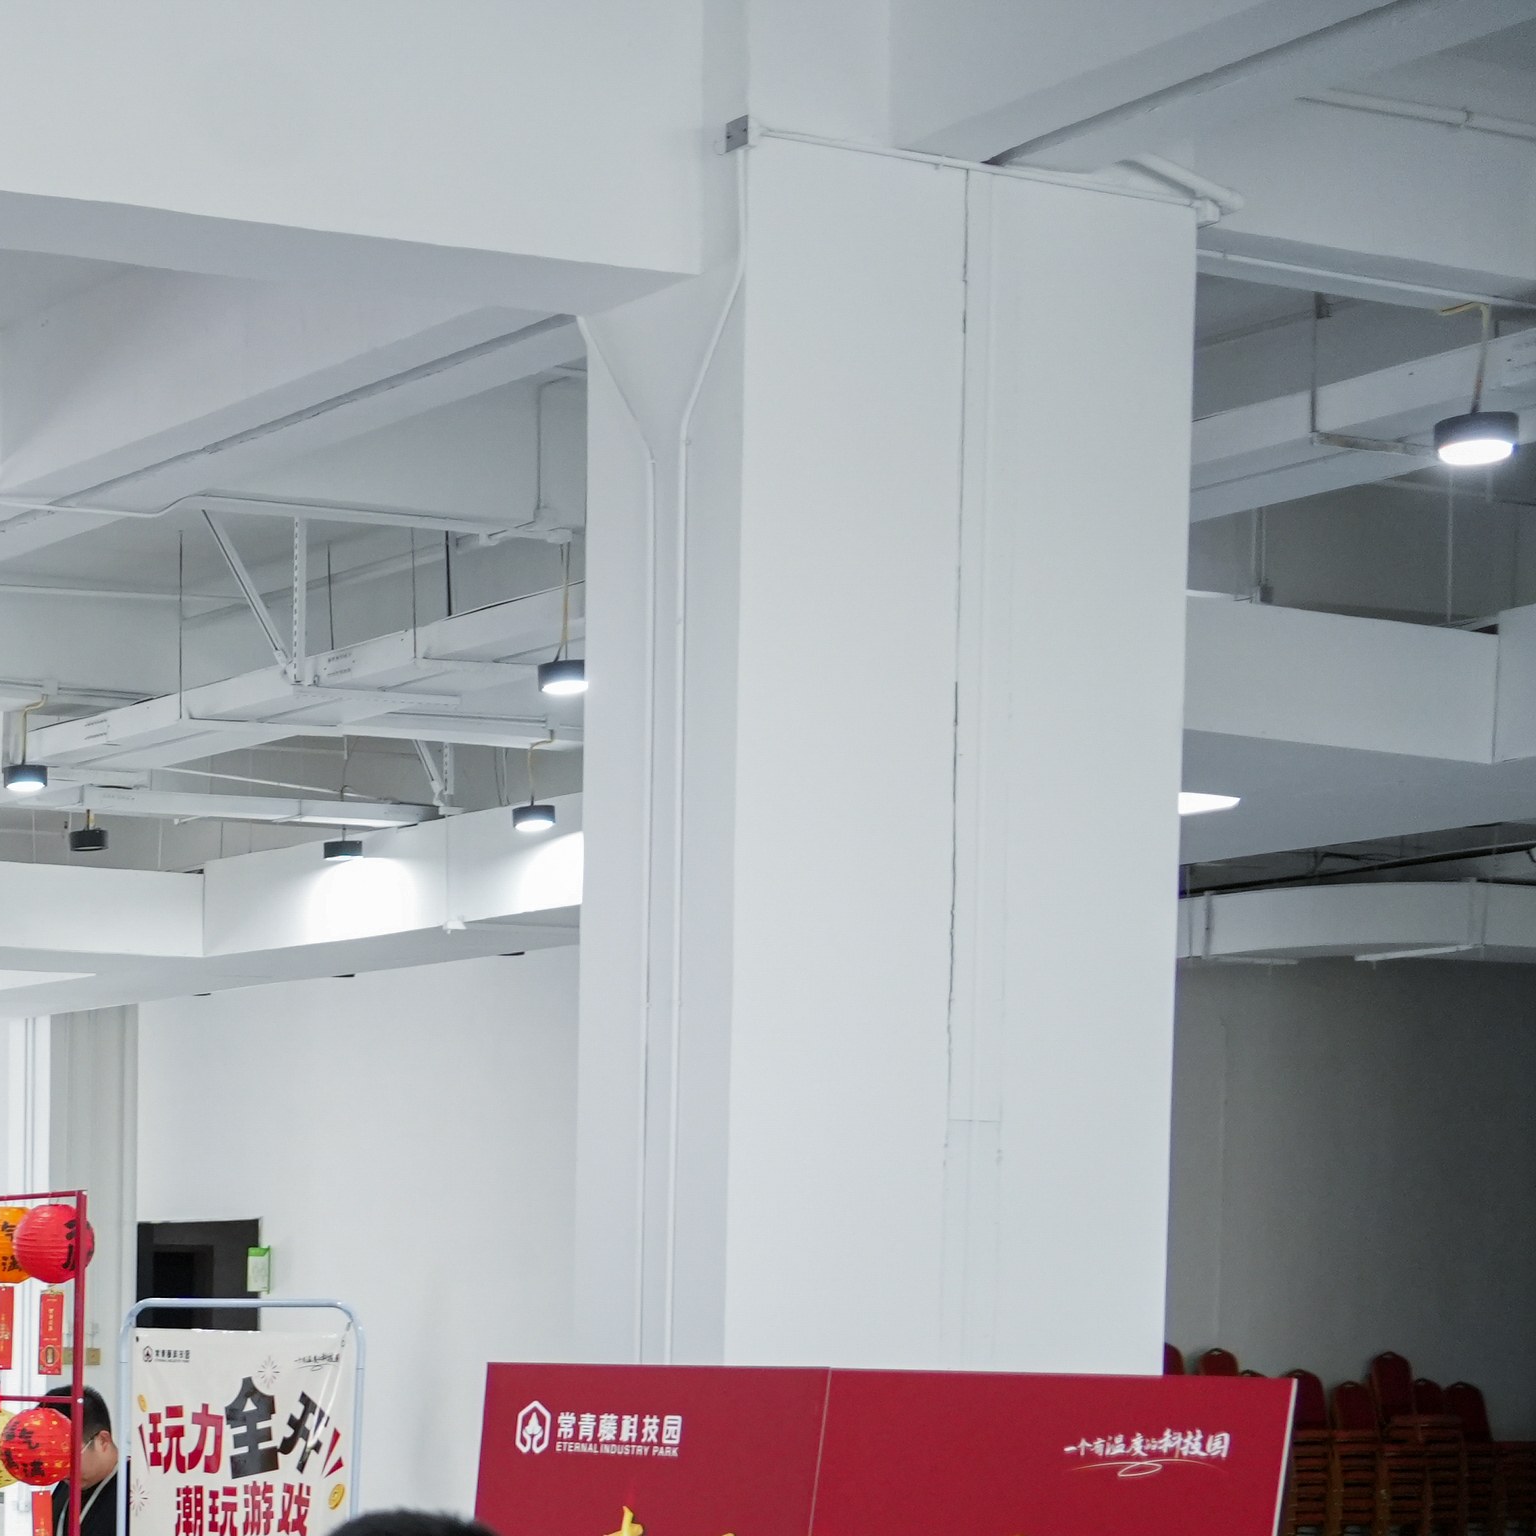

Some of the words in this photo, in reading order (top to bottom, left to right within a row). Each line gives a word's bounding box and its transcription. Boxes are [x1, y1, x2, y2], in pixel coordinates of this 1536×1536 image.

[148, 1376, 330, 1480] 玩力全开
[557, 1412, 682, 1445] 常青藤科技园
[1064, 1427, 1230, 1459] 一个有温度的科技园
[555, 1441, 599, 1454] ETERNAL
[600, 1443, 649, 1456] INDUSTRY
[652, 1445, 680, 1457] PARK
